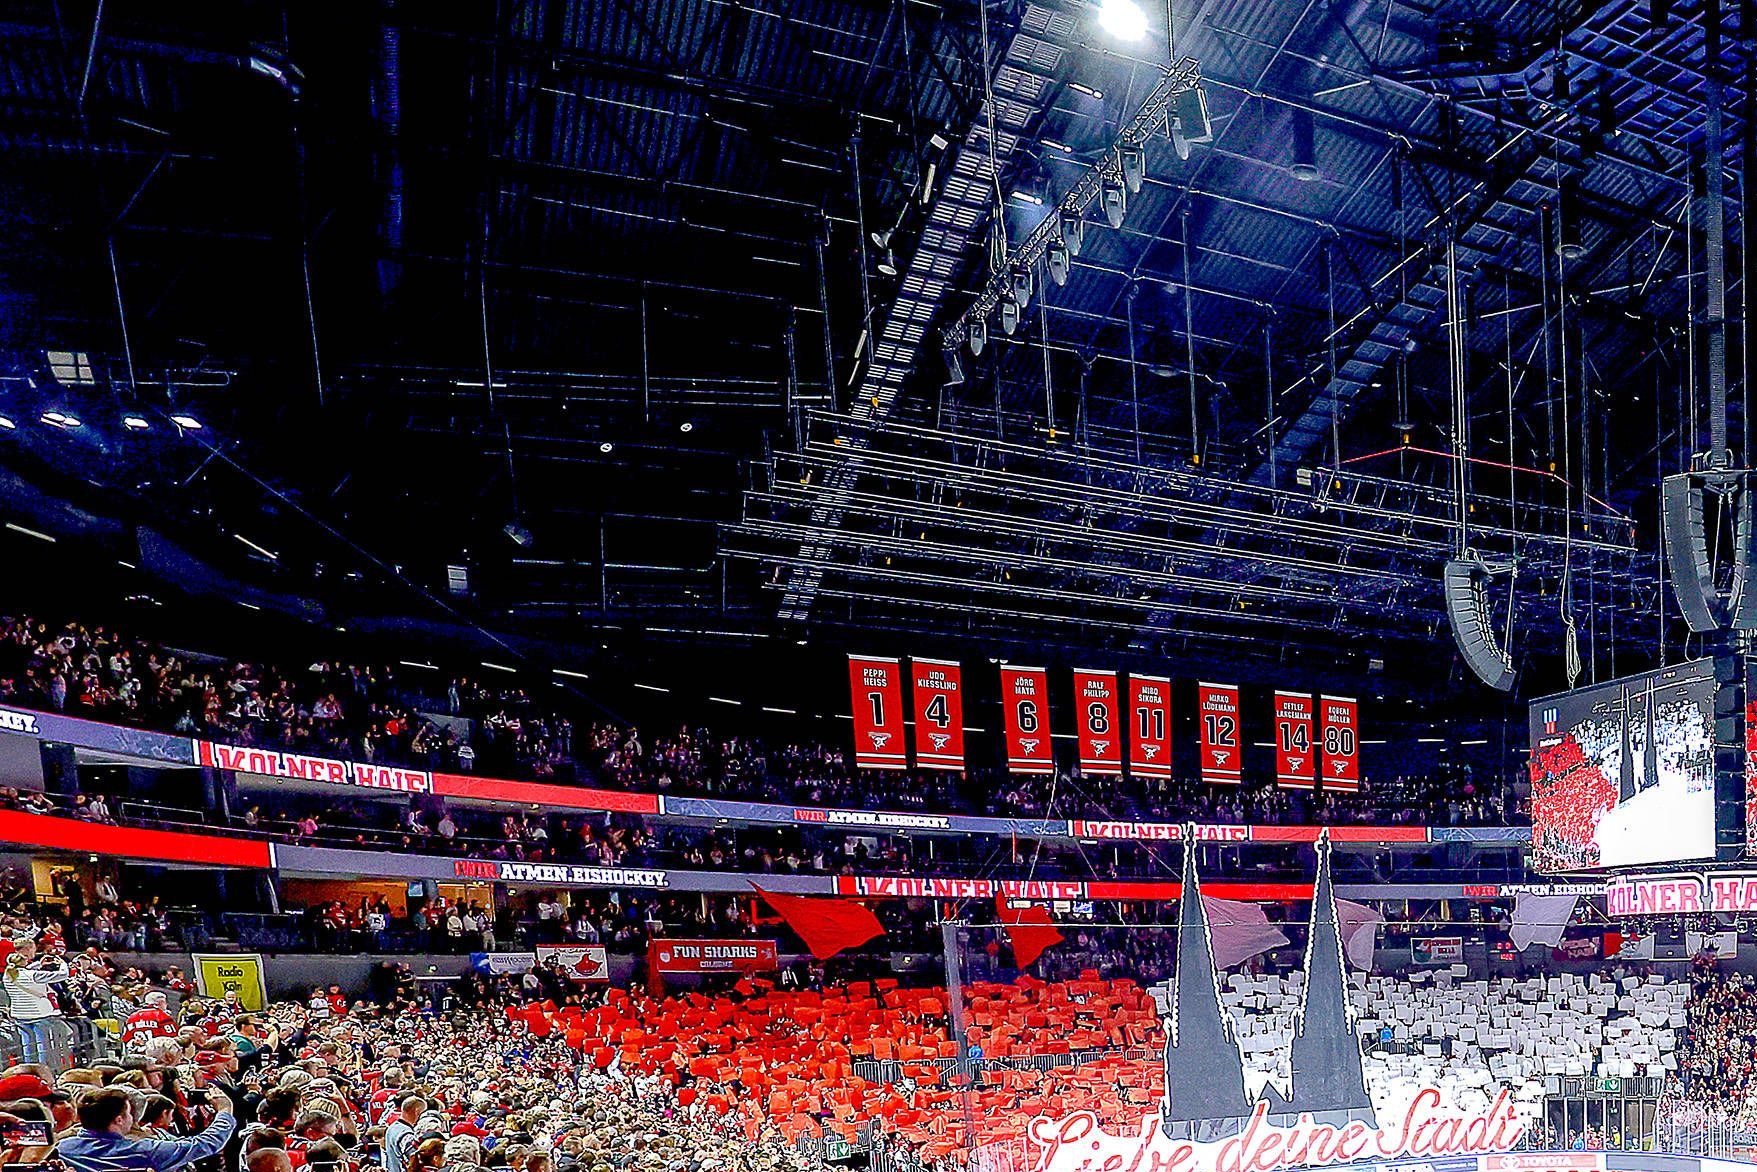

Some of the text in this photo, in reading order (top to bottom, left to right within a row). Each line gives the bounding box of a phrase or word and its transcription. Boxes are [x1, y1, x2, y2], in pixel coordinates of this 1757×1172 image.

[863, 668, 886, 678] PEPPI
[929, 671, 945, 680] UDO
[863, 677, 887, 687] HEISS
[917, 679, 957, 690] KIESSLING
[1015, 676, 1034, 686] JÖRG
[1087, 681, 1105, 689] RALF
[1015, 686, 1035, 695] MAYR
[868, 692, 884, 726] 1
[925, 694, 950, 728] 4
[1017, 700, 1038, 733] 6
[1087, 702, 1109, 734] 8
[1137, 707, 1164, 740] 11
[1204, 715, 1235, 746] 12
[1279, 722, 1309, 753] 14
[1324, 726, 1355, 756] 80
[673, 945, 758, 959] FUN SHARKS
[218, 966, 243, 977] Radio
[223, 980, 243, 992] Köln
[1378, 1088, 1524, 1154] Stadt
[1523, 1155, 1573, 1168] TOYOTA
